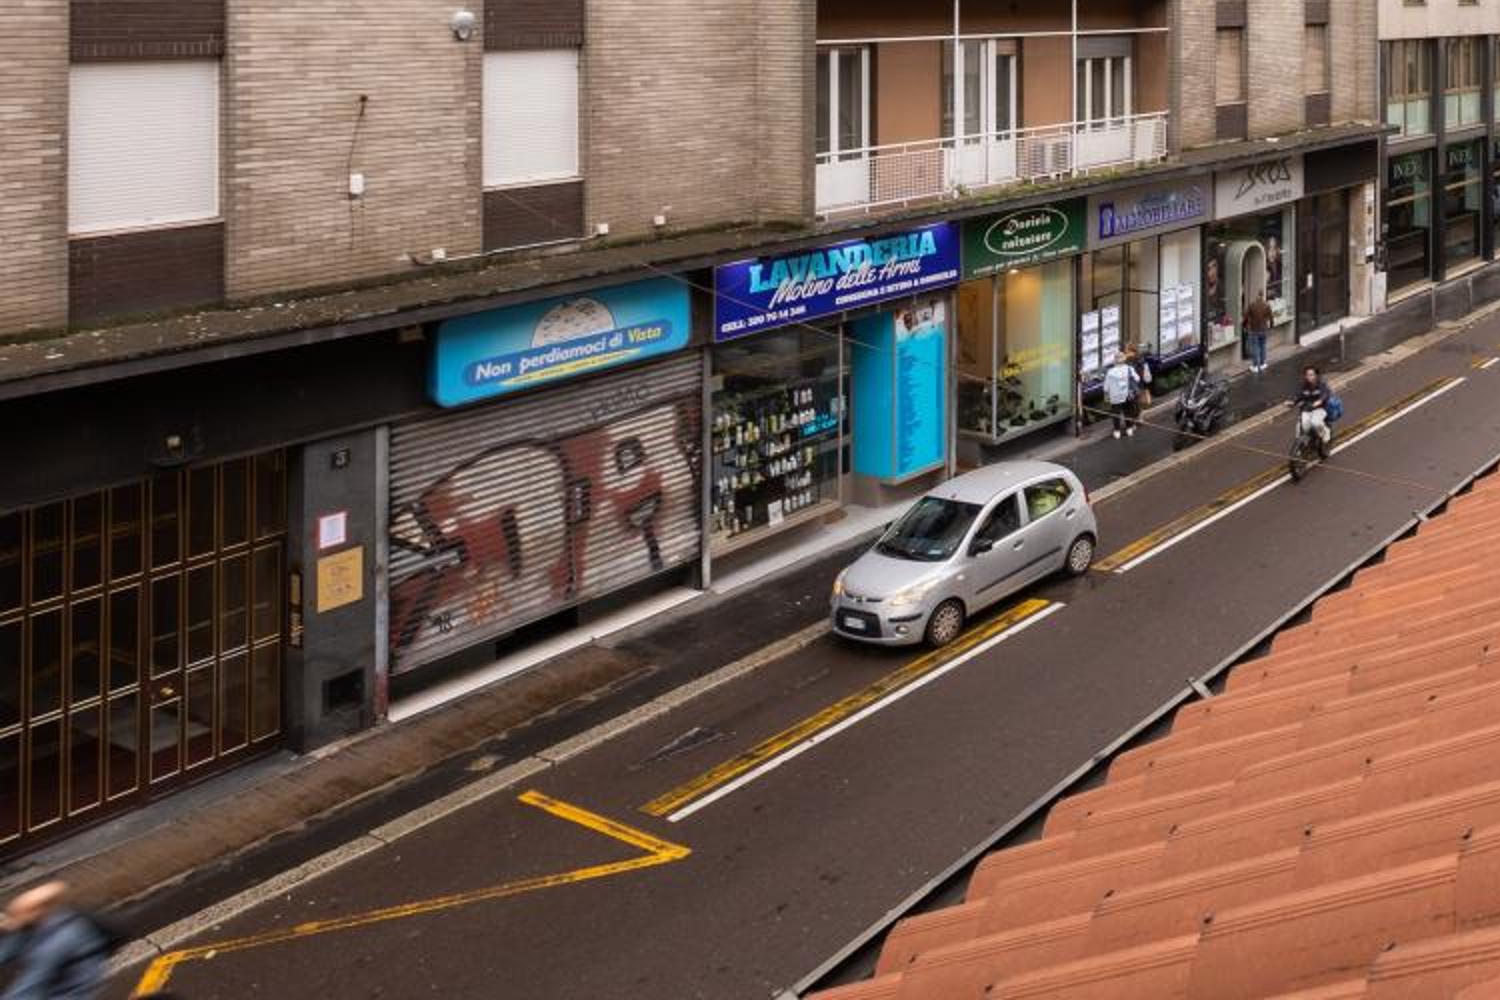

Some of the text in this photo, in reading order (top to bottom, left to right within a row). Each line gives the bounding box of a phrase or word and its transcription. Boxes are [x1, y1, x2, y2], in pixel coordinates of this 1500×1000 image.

[749, 231, 937, 293] LAVANDERIA
[768, 257, 921, 309] Molino delle Armi
[475, 362, 511, 382] Non
[519, 337, 606, 375] perdiamoci
[609, 330, 623, 347] di
[627, 325, 662, 344] Vista
